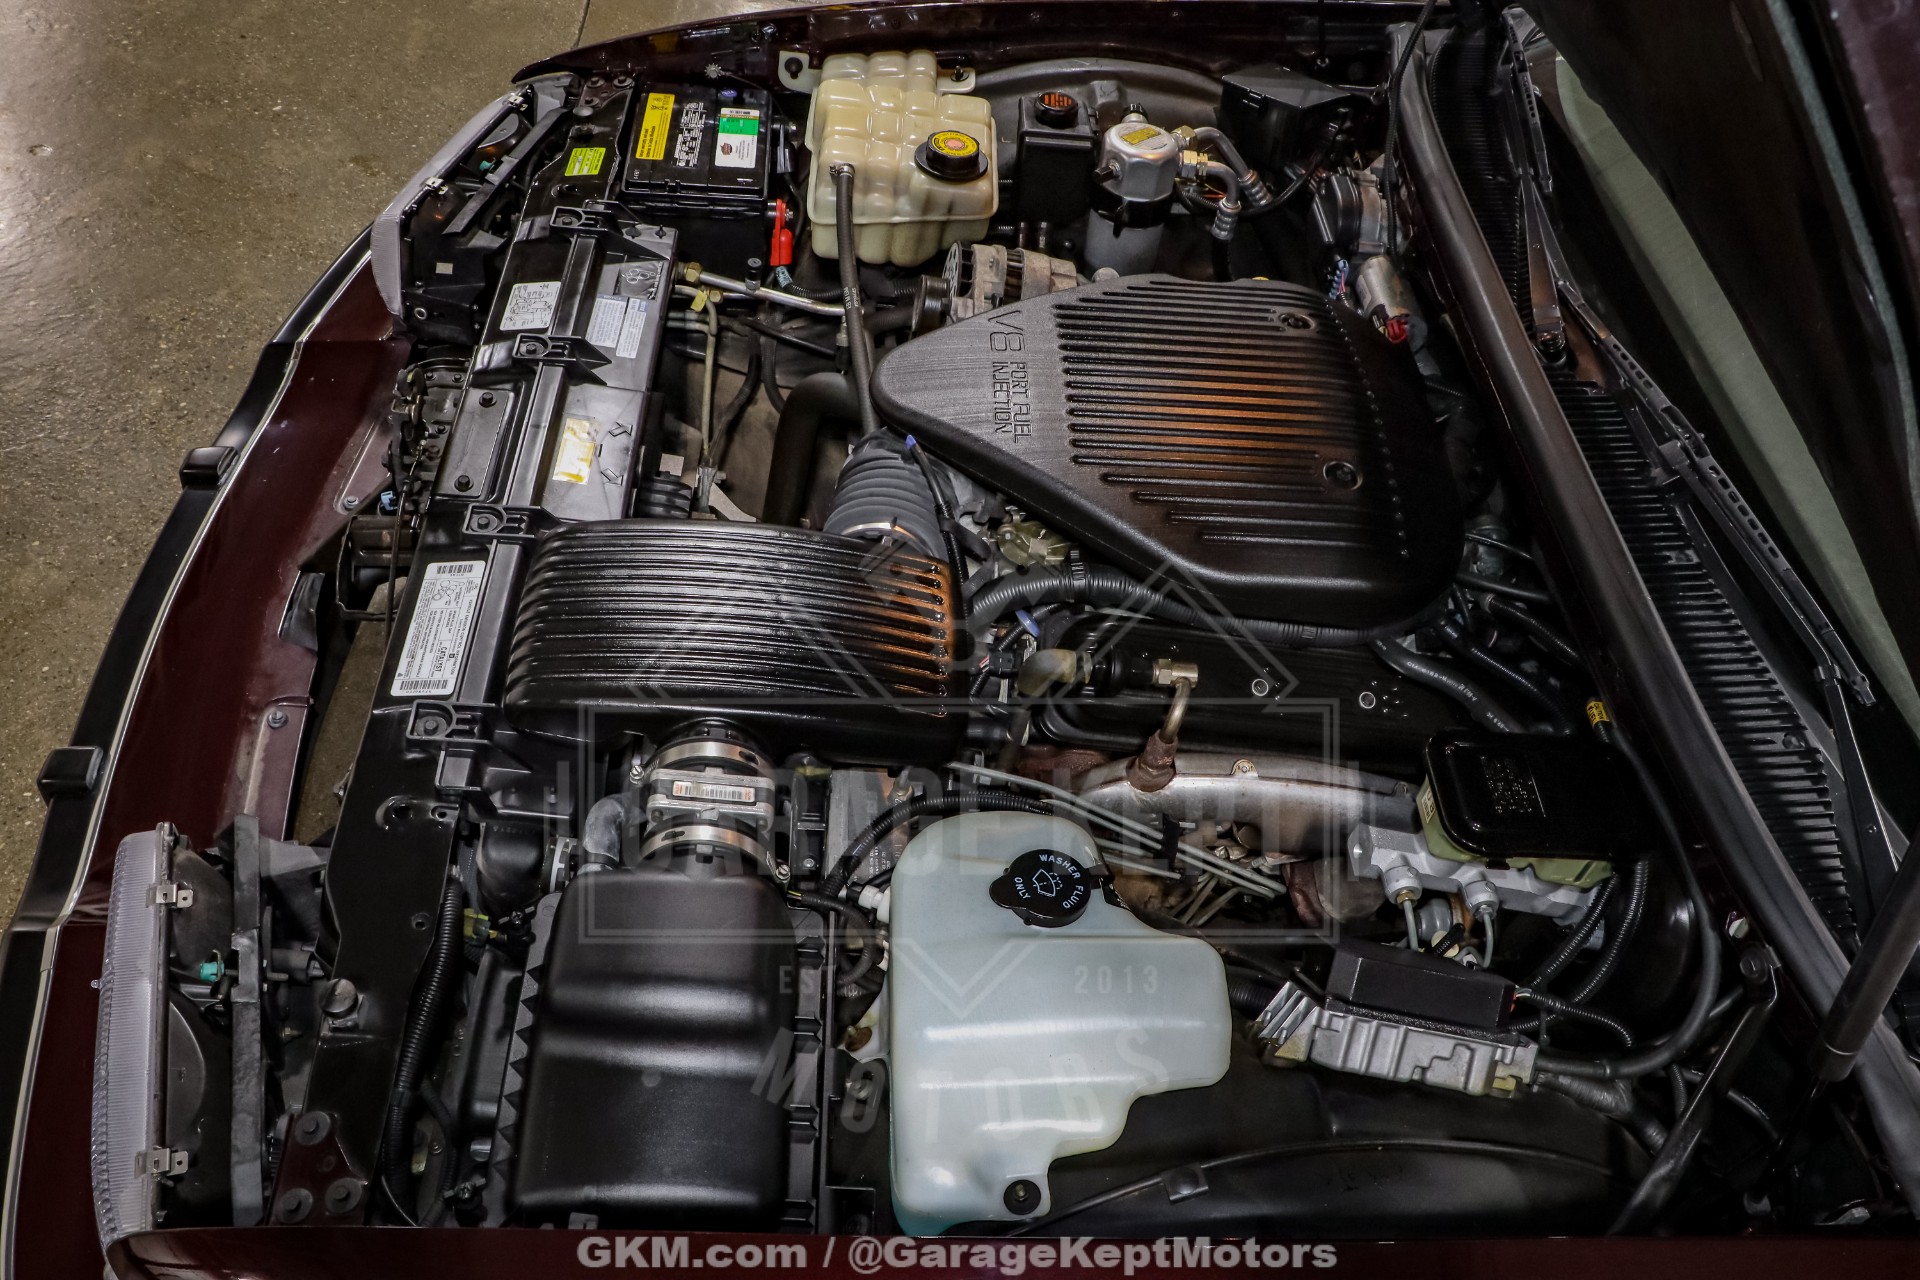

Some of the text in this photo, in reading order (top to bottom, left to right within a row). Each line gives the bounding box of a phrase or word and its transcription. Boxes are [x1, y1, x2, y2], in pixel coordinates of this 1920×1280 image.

[988, 310, 1025, 351] V8
[992, 361, 1012, 433] INJECTION
[1010, 361, 1032, 444] PORT FUEL
[434, 646, 447, 672] CATALYST
[1014, 854, 1084, 909] WASHER FLUID ONLY
